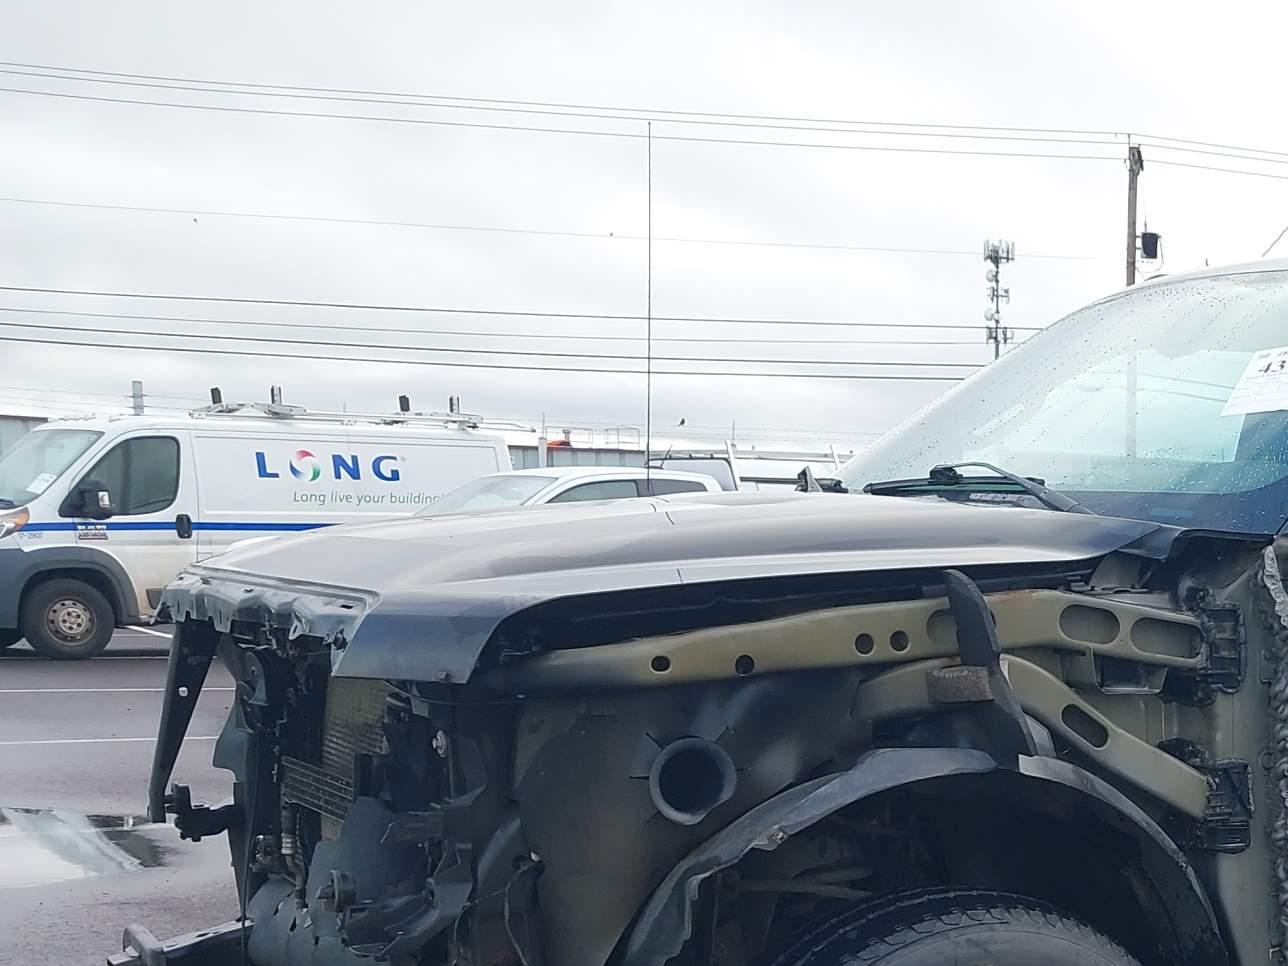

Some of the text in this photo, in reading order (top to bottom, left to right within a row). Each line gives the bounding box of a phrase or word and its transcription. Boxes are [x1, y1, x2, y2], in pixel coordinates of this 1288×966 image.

[254, 449, 401, 482] LONG
[293, 490, 326, 506] Long
[331, 491, 353, 503] live
[356, 493, 387, 506] your
